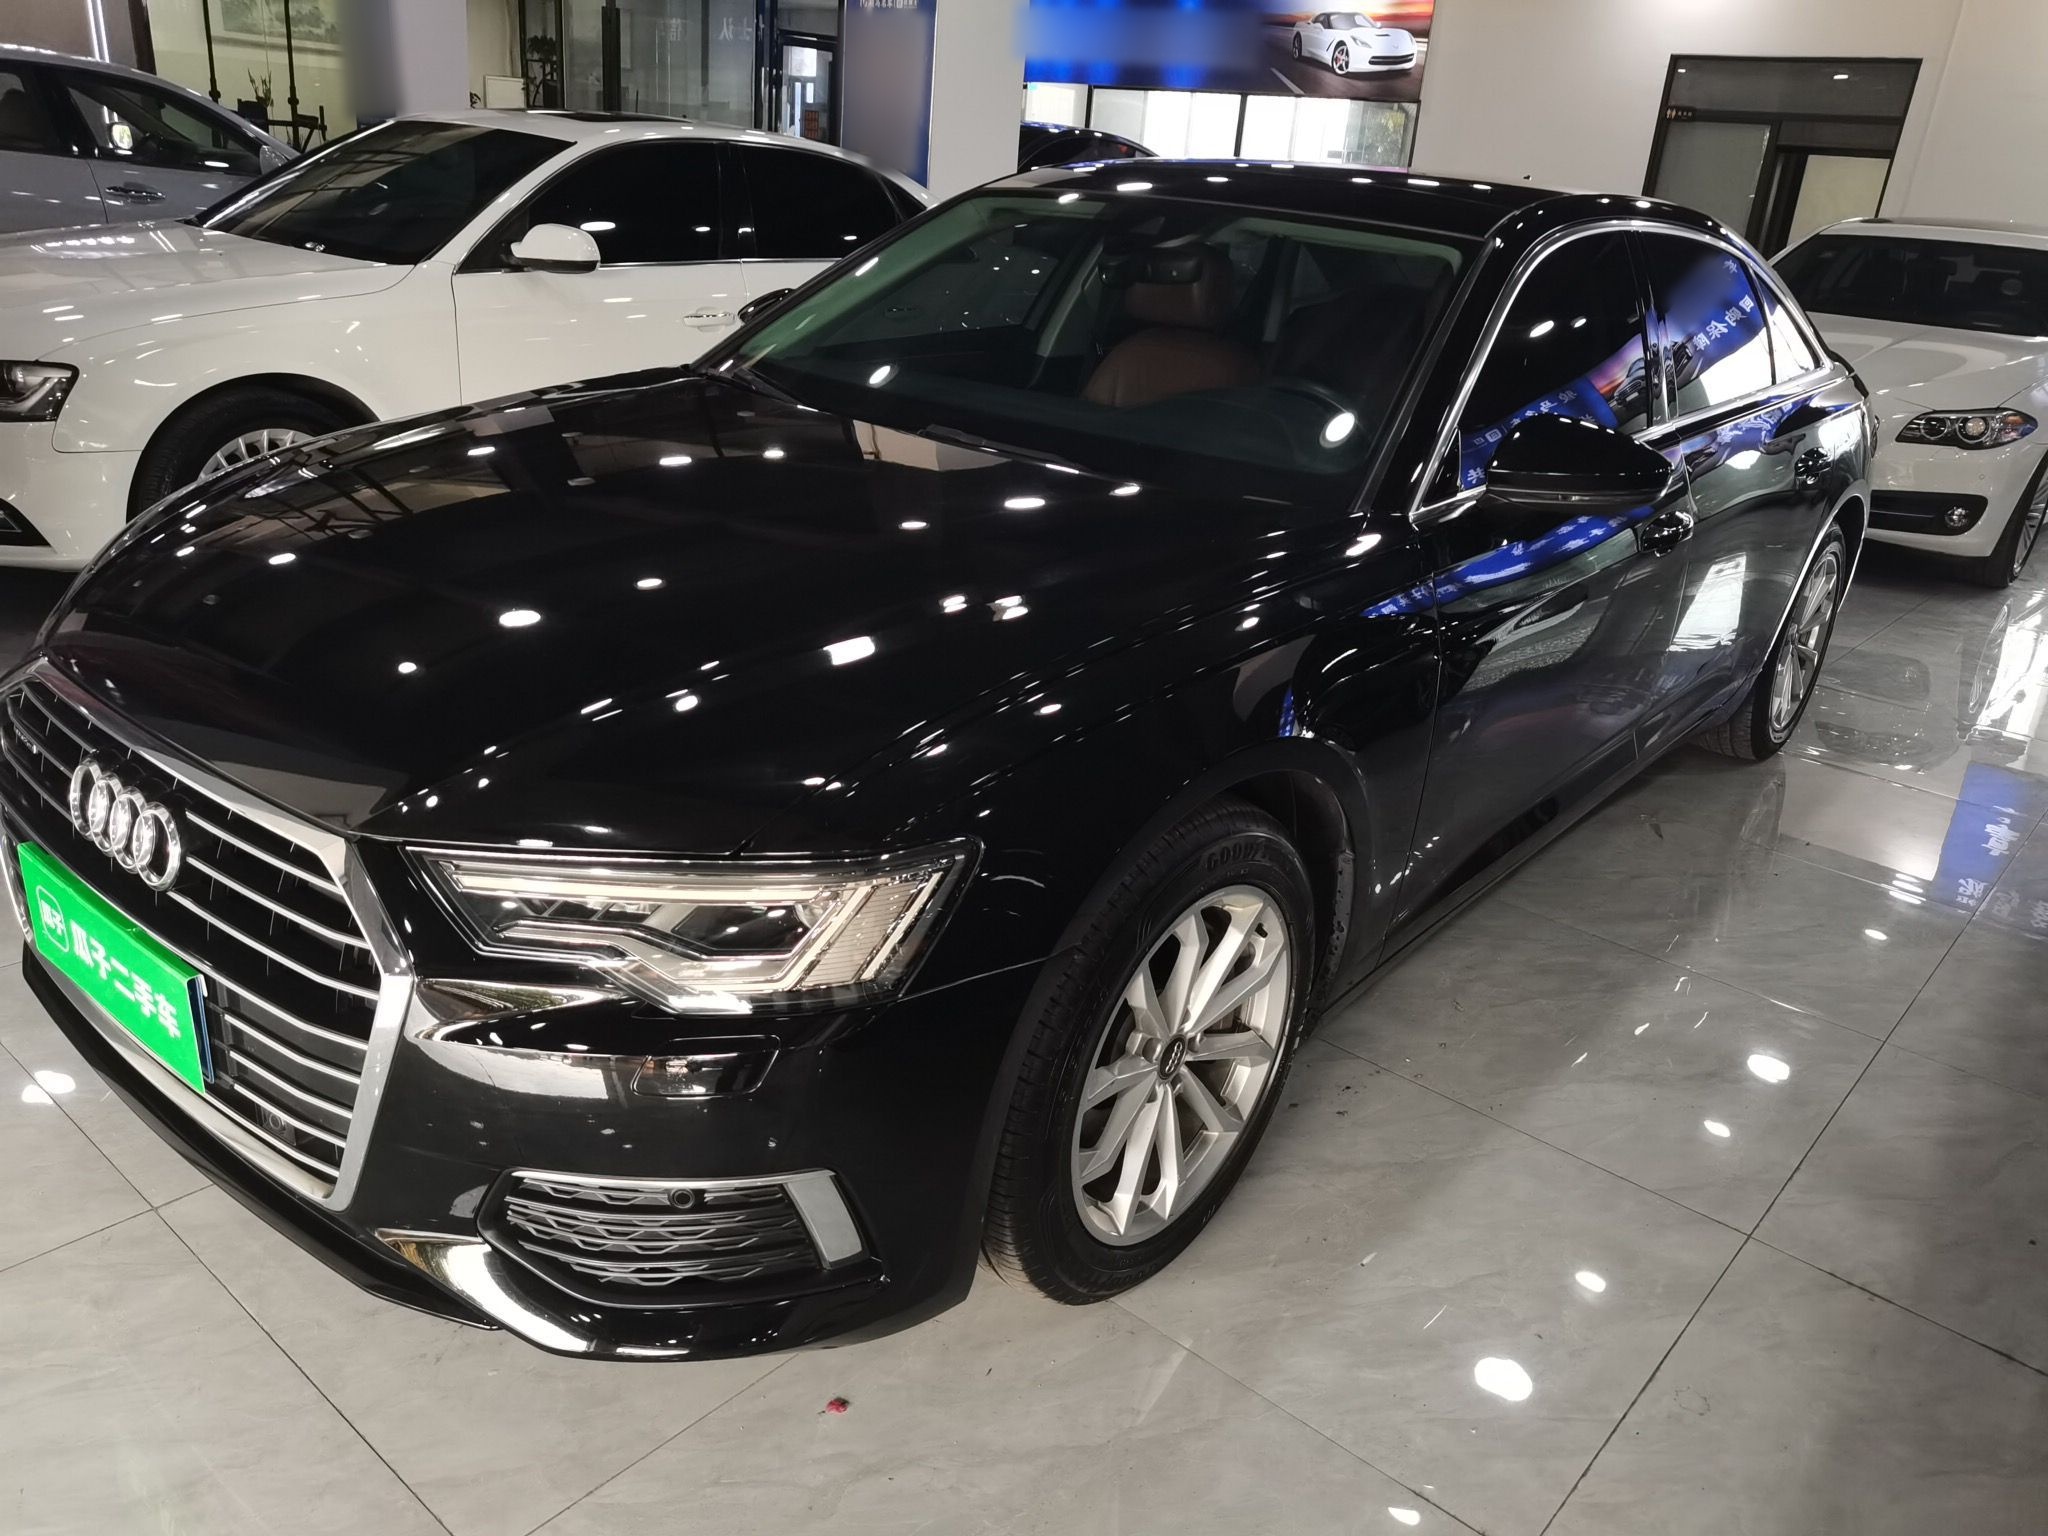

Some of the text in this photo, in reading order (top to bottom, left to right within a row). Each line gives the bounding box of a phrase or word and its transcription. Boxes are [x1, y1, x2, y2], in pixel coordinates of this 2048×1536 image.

[70, 919, 182, 1039] 瓜子二手车
